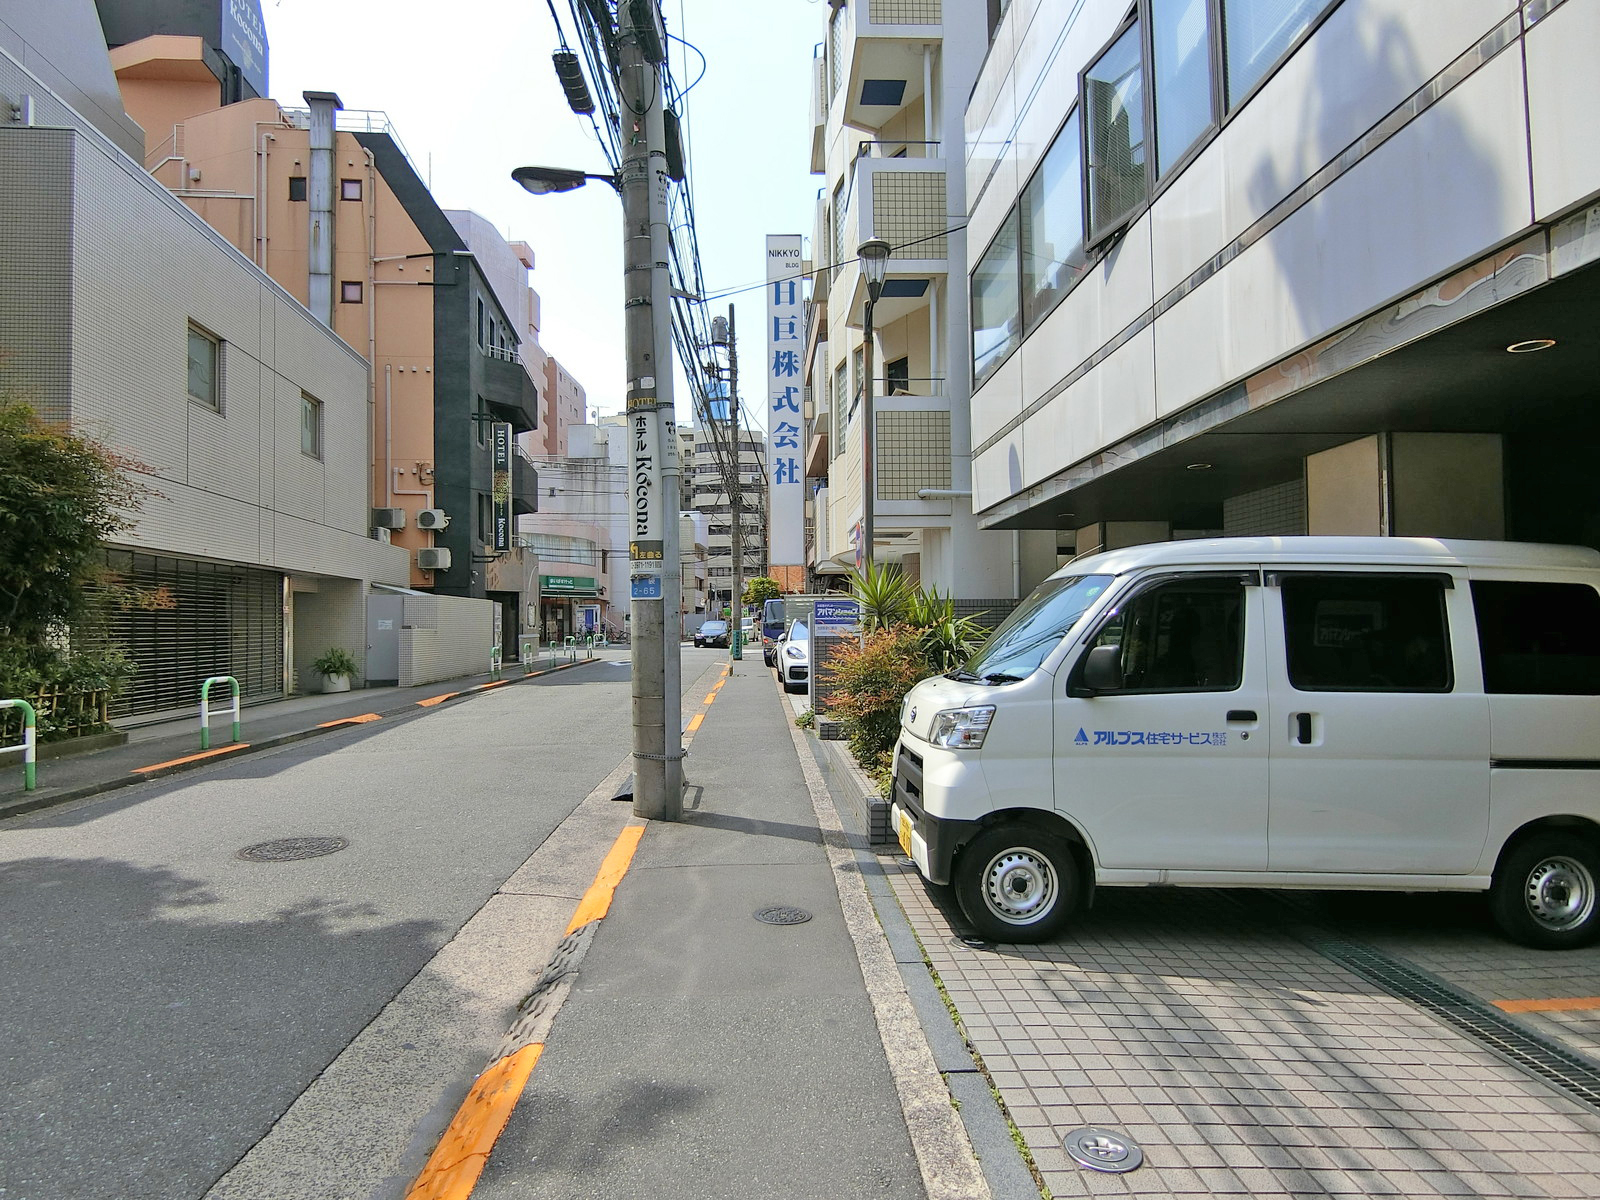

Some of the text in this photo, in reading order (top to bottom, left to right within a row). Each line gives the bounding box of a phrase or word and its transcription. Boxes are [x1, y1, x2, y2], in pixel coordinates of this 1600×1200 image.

[230, 0, 263, 56] Kocona
[236, 0, 264, 38] OTEL
[769, 249, 800, 258] NIKKYO
[772, 280, 800, 485] 日巨株式会社
[497, 430, 505, 464] HOTEL
[635, 416, 653, 536] ホテル Kocona
[498, 518, 506, 547] Kocona
[633, 587, 655, 595] 2-65
